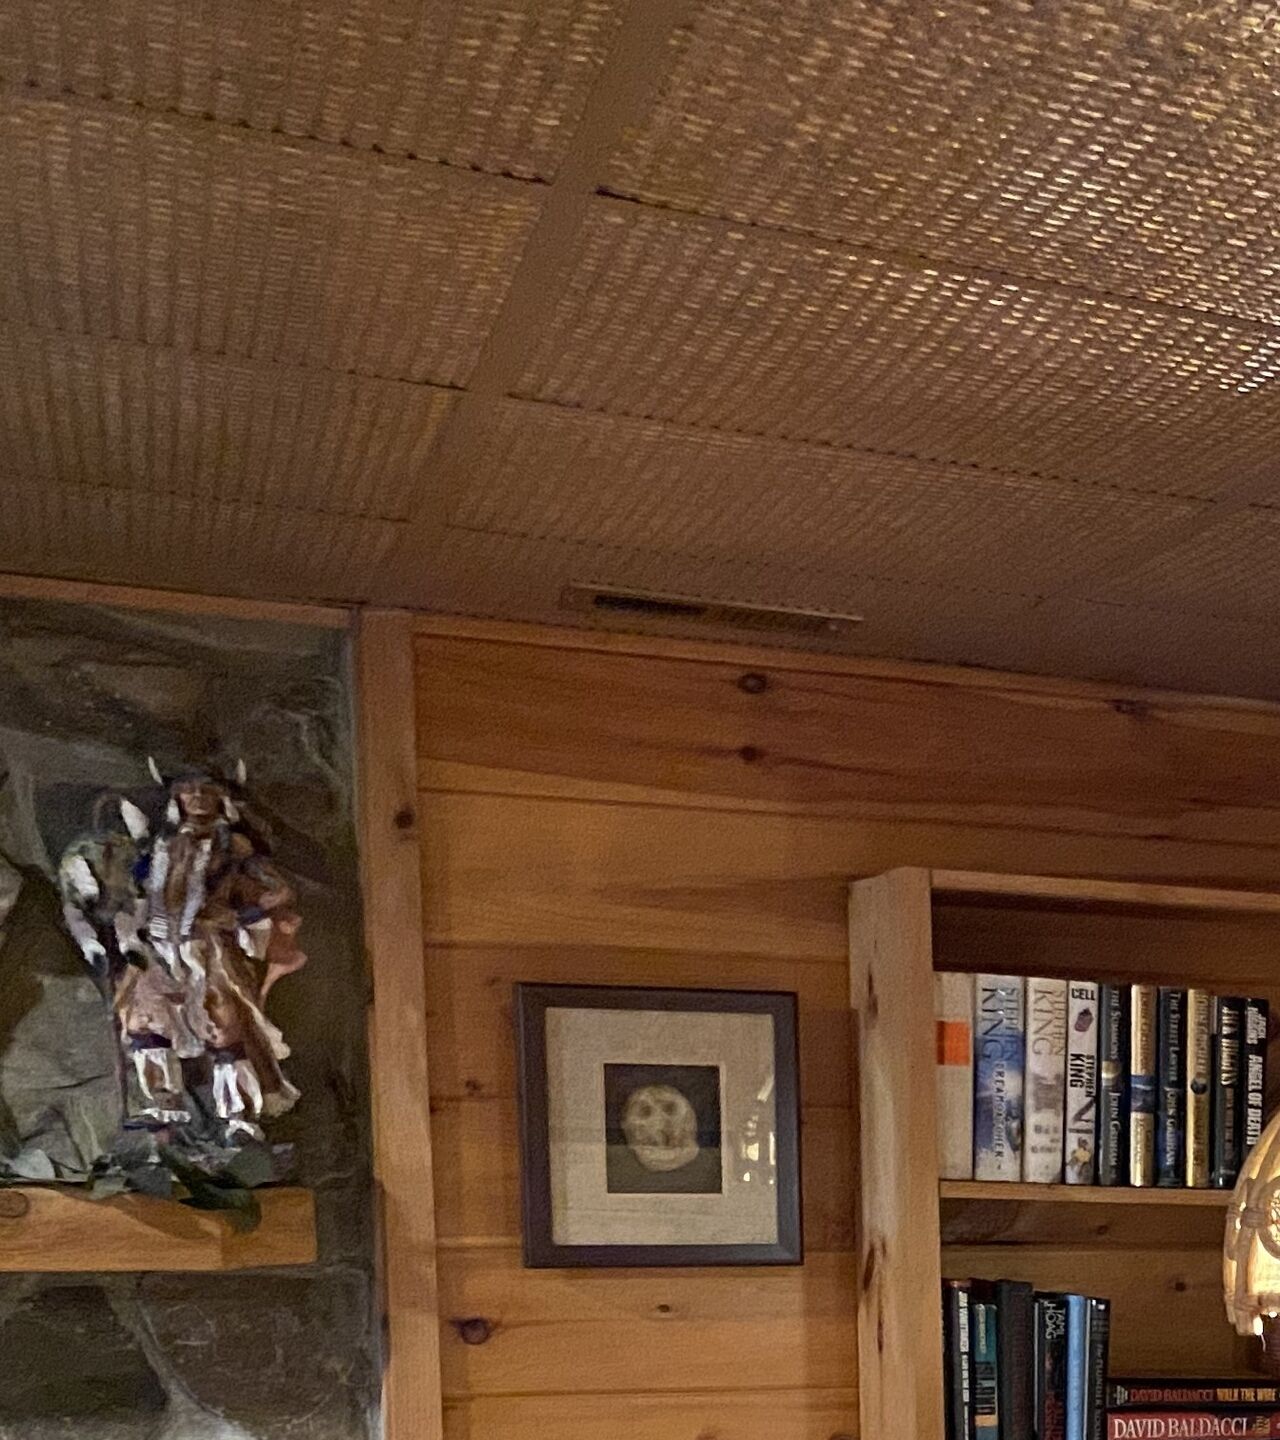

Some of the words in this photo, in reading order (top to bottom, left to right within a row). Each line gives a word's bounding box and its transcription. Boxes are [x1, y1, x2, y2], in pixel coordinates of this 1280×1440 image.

[1072, 988, 1096, 1000] CELL
[1169, 993, 1181, 1009] THE
[982, 988, 1005, 1059] KING
[1005, 988, 1018, 1061] STEPHEN
[1031, 988, 1053, 1056] KING
[1053, 990, 1065, 1057] STEPHEN
[1168, 1013, 1181, 1044] STREET
[1068, 1053, 1084, 1088] KING
[1085, 1055, 1096, 1097] STEPHEN
[1247, 1054, 1263, 1090] ANGEL
[1108, 1092, 1121, 1118] JOHN
[1165, 1087, 1180, 1116] JOHN
[1247, 1092, 1262, 1106] OF
[1109, 1121, 1121, 1165] GRISHAM
[1165, 1118, 1179, 1166] GRISHAM
[1246, 1108, 1262, 1145] DEATH
[1045, 1303, 1056, 1340] HOAG
[1054, 1309, 1065, 1336] TAMI
[1130, 1389, 1162, 1401] DAVID
[1113, 1418, 1164, 1439] DAVID
[1168, 1416, 1248, 1438] BALDACCI
